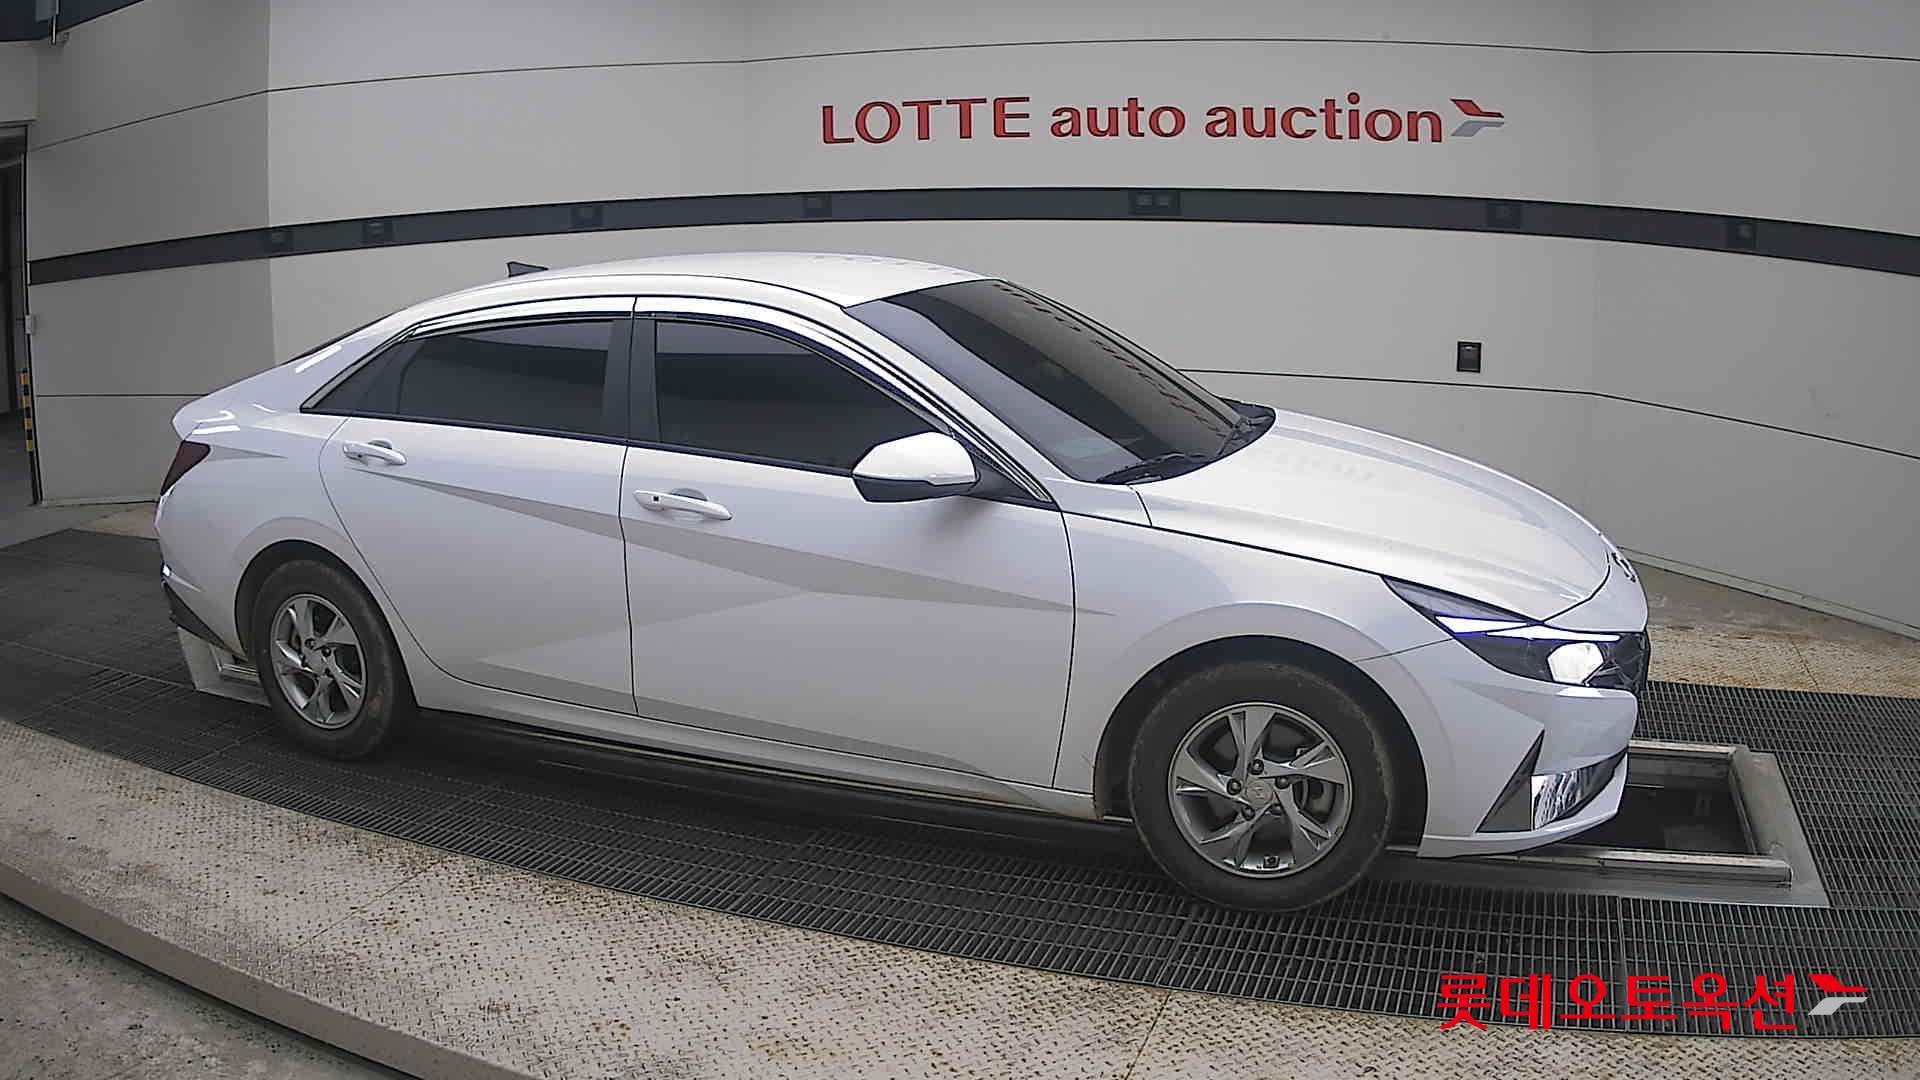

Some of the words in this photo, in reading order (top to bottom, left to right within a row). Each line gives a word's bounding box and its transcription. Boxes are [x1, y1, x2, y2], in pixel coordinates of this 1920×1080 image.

[822, 97, 1031, 144] LOTTE
[1050, 97, 1186, 138] auto
[1204, 91, 1443, 143] auction
